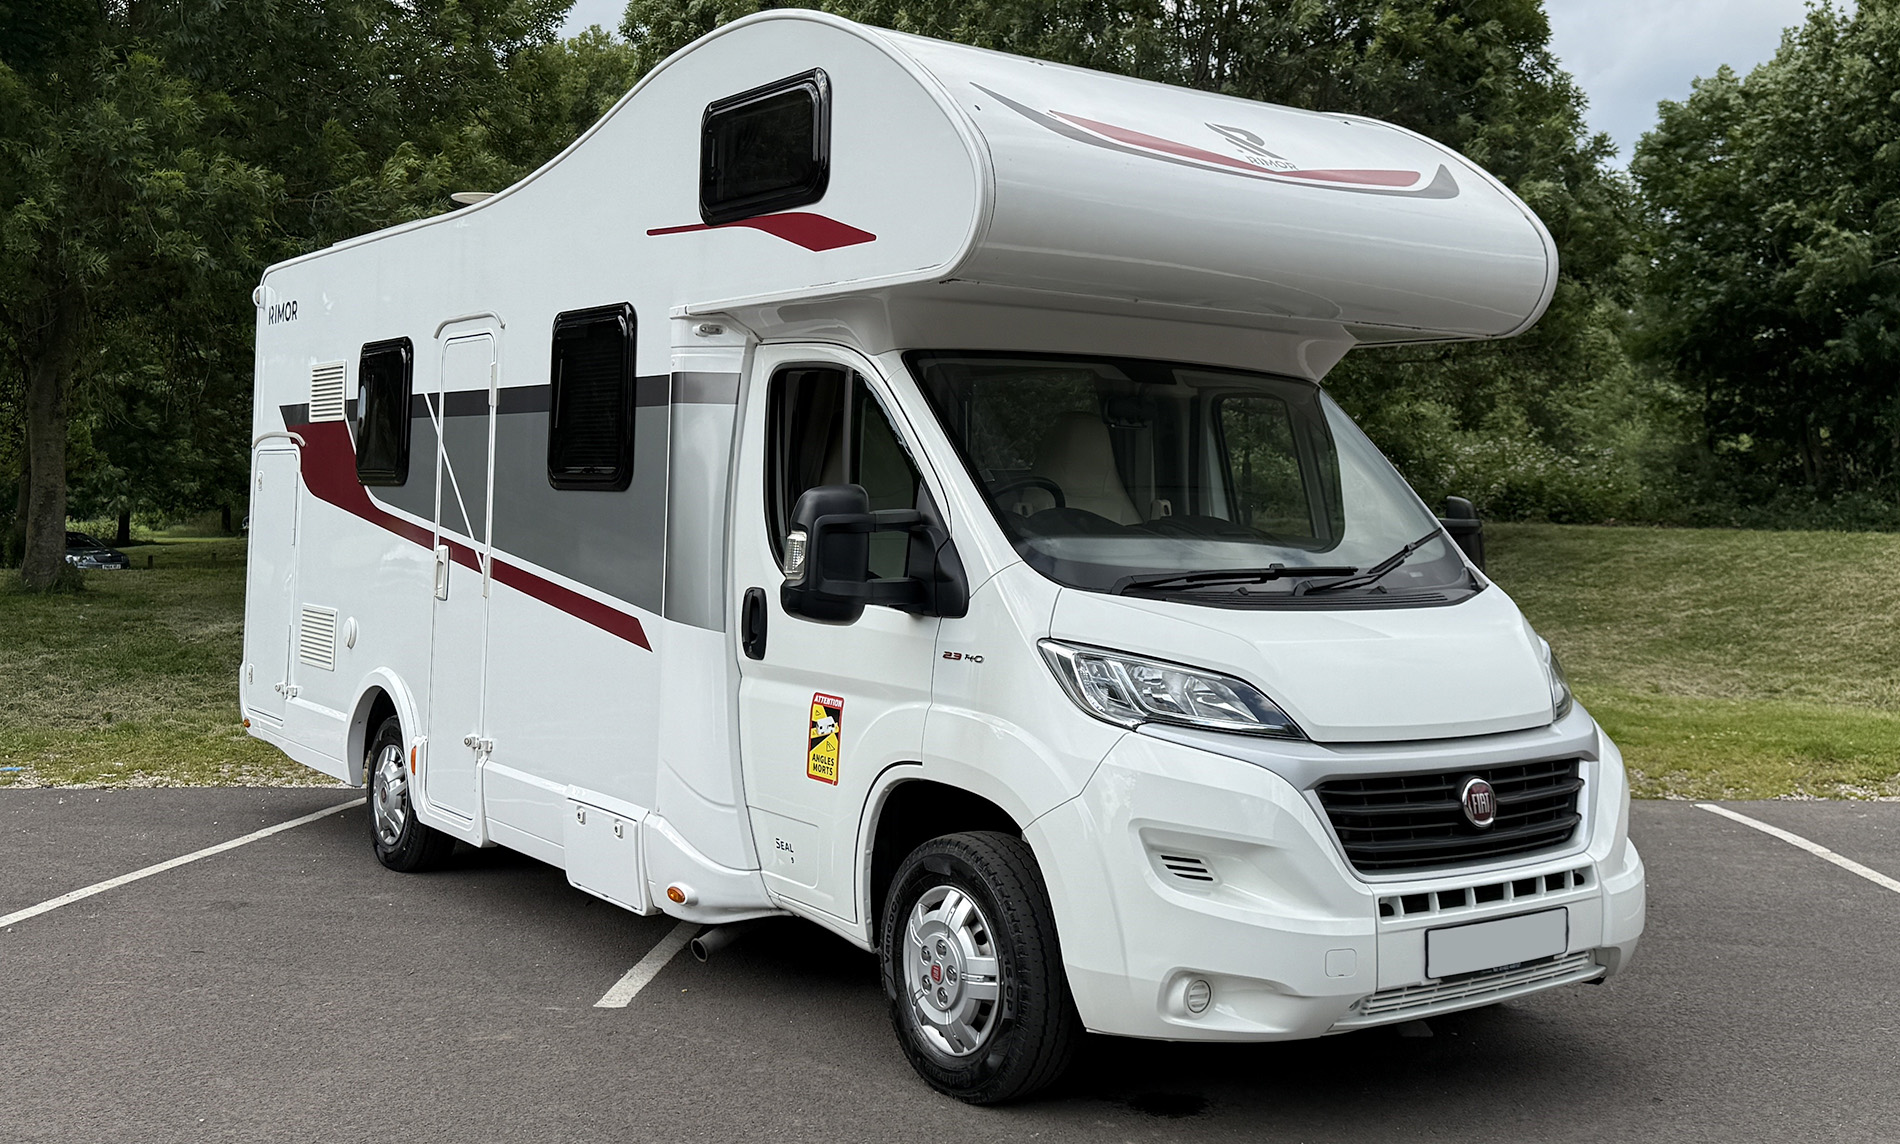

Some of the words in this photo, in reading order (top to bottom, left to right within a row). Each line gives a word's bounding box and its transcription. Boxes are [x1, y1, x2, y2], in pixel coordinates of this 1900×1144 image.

[1245, 155, 1299, 171] RIMOR
[268, 300, 298, 325] RIMOR
[814, 695, 842, 708] ATTENTION
[812, 753, 834, 767] ANGLES
[812, 762, 834, 776] MORTS
[1471, 792, 1490, 814] FIAT
[775, 837, 794, 853] SEAL
